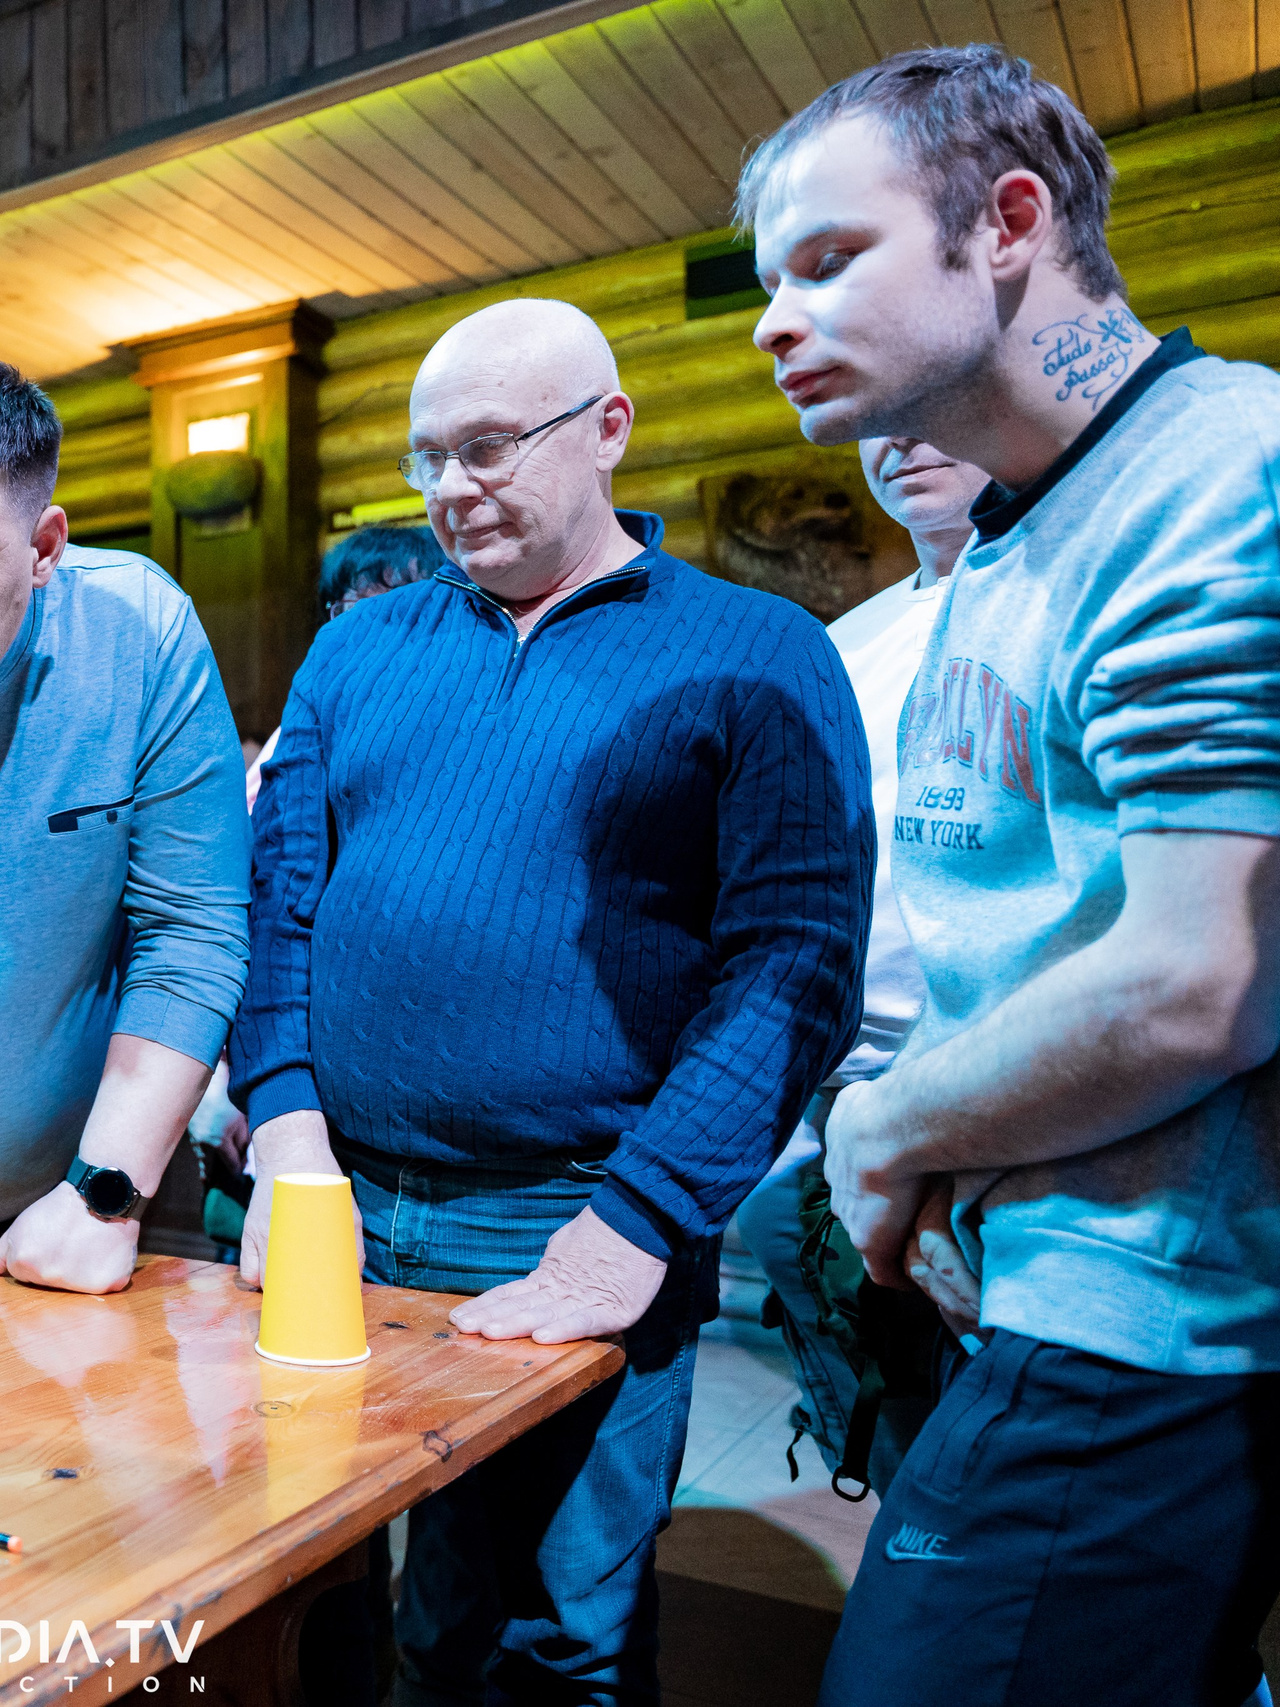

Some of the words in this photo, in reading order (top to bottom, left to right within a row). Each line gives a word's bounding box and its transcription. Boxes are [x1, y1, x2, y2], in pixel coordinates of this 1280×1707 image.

[894, 815, 925, 844] NEW
[930, 820, 985, 850] YORK
[893, 1522, 950, 1557] NIKE
